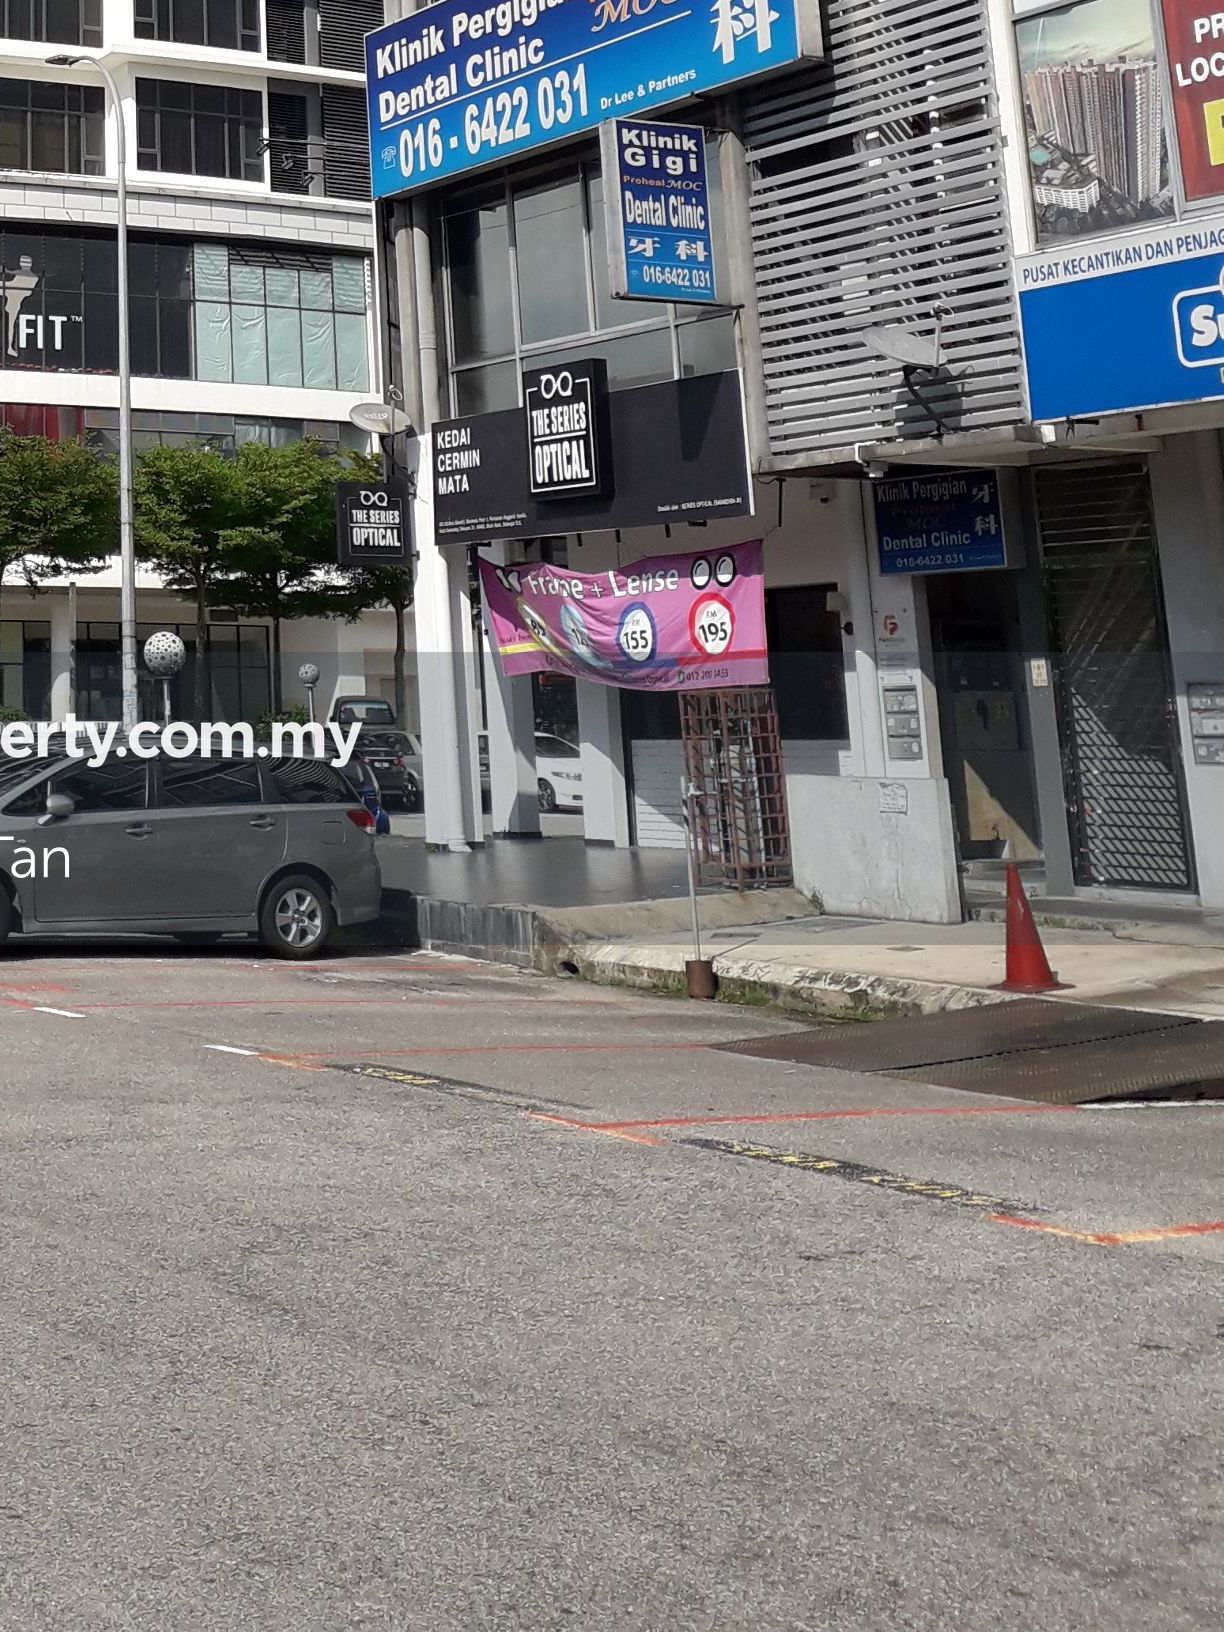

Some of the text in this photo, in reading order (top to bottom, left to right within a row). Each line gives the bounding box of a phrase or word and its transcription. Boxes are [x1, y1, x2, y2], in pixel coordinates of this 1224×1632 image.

[375, 24, 446, 80] Klinik
[378, 35, 545, 123] Dental Clinic
[600, 69, 697, 111] Dr Lee & Partners
[399, 118, 443, 179] 016
[464, 85, 531, 156] 6422
[537, 62, 588, 131] 031
[621, 128, 698, 152] Klinik
[623, 147, 698, 175] Gigi
[623, 175, 703, 192] Proheal MOC
[624, 191, 706, 230] Dental Clinic
[1022, 262, 1060, 285] PUSAT
[1062, 245, 1143, 276] KECANTIKAN
[1144, 239, 1173, 261] DAN
[643, 265, 712, 288] 016-6422 031
[18, 313, 68, 351] FIT
[531, 401, 587, 433] THE SERIES
[436, 427, 471, 449] KEDAI
[437, 448, 481, 472] CERMIN
[534, 438, 591, 485] OPTICAL
[438, 475, 470, 496] MATA
[877, 477, 968, 503] Klinik Pergigian
[351, 508, 401, 525] THE SERIES
[352, 527, 402, 548] OPTICAL
[882, 530, 972, 551] Dental Clinic
[945, 553, 964, 564] 031
[527, 574, 585, 600] Frame
[608, 569, 680, 599] Lense
[623, 630, 650, 650] 155
[698, 621, 728, 644] 195
